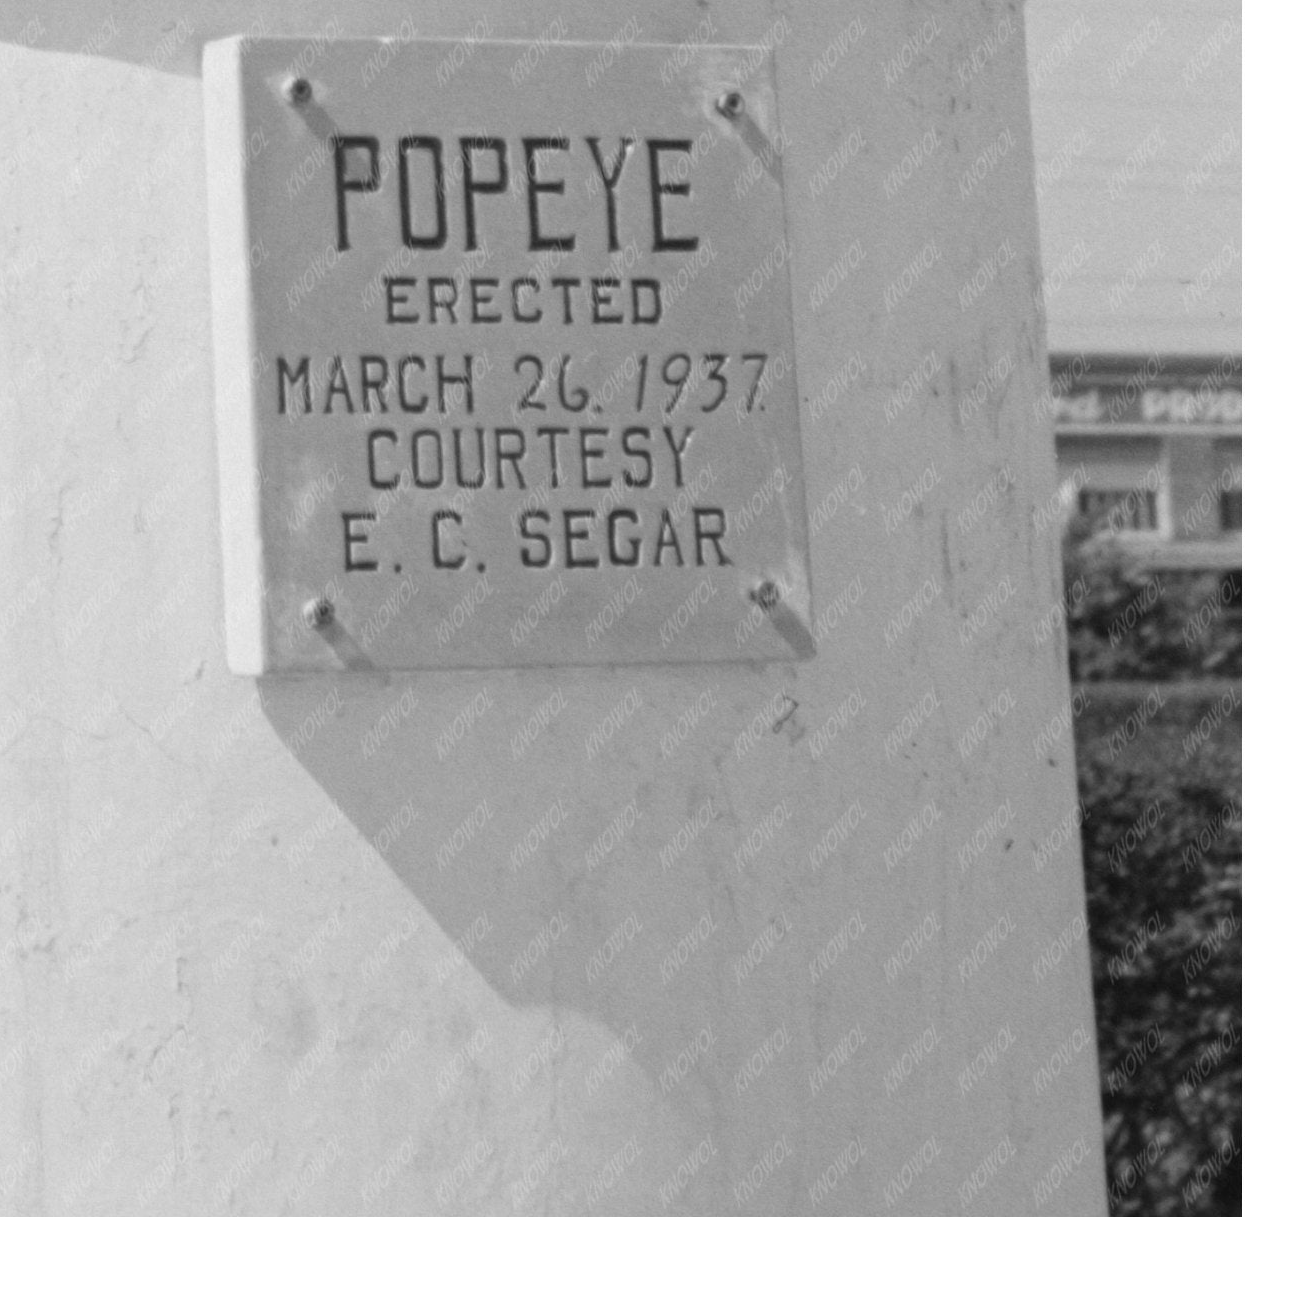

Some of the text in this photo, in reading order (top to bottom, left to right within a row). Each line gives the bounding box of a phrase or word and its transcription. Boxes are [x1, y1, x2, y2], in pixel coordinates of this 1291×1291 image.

[327, 135, 701, 253] POPEYE
[383, 276, 663, 326] ERECTED
[276, 355, 475, 415] MARCH
[366, 426, 695, 491] COURTESY
[340, 507, 736, 575] E. C. SEGAR
